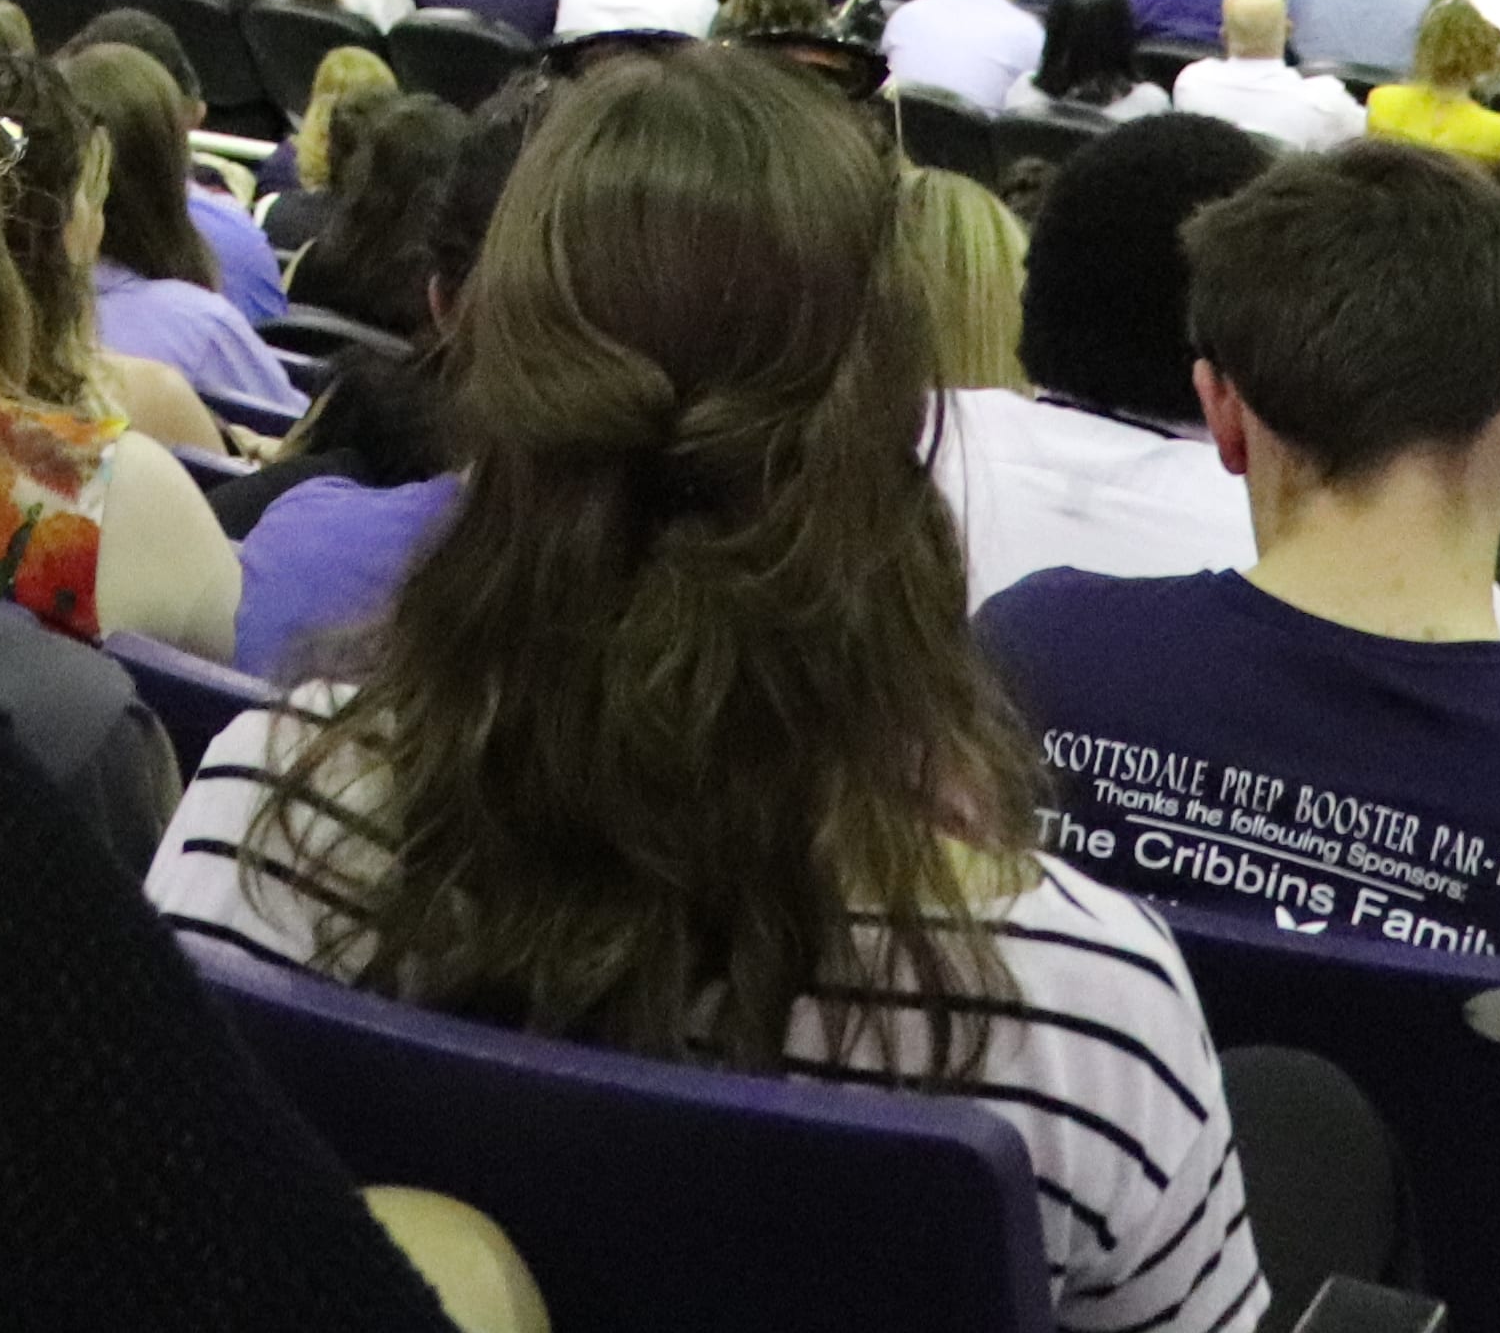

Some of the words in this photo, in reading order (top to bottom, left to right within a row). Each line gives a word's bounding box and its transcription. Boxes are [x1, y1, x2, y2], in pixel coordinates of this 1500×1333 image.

[1042, 729, 1208, 797] SCOTTSDALE
[1219, 767, 1284, 812] PREP
[1295, 785, 1420, 856] BOOSTER
[1094, 779, 1179, 819] Thanks
[1186, 796, 1222, 829] the
[1228, 808, 1342, 863] following
[1346, 841, 1467, 902] Sponsors:
[1034, 807, 1117, 859] The
[1134, 830, 1336, 916] Cribbins
